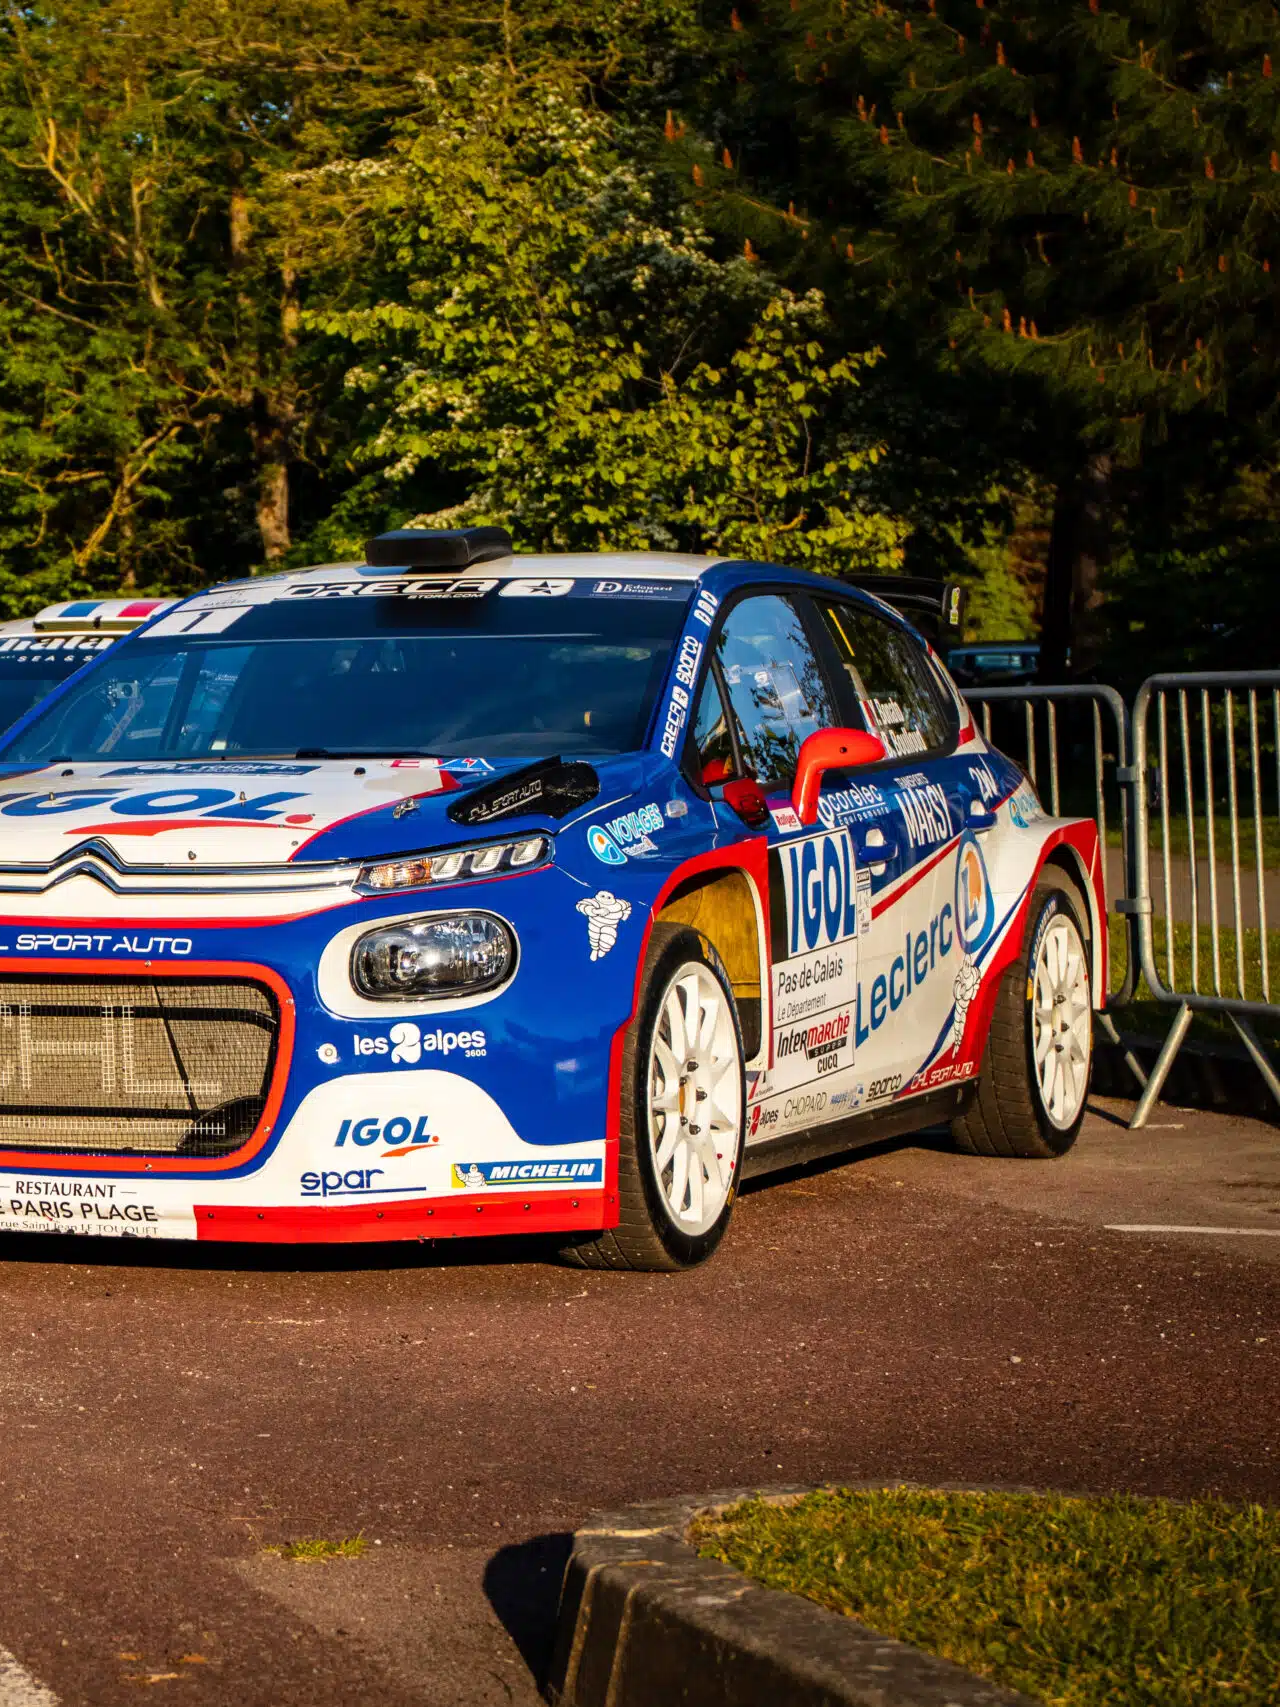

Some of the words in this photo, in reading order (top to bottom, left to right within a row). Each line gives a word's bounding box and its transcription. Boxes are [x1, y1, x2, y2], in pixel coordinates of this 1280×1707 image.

[179, 611, 214, 632] 1
[675, 635, 703, 690] sparco
[519, 779, 542, 800] AUTO
[604, 803, 665, 845] VOYAGES
[894, 783, 955, 849] MARSY
[789, 834, 856, 954] IGOL
[16, 934, 112, 952] SPORT
[112, 936, 193, 954] AUTO
[855, 902, 953, 1050] Leclerc
[354, 1034, 387, 1055] les
[390, 1022, 421, 1064] 2
[423, 1028, 487, 1056] alpes
[465, 1048, 487, 1058] 3600
[817, 1053, 839, 1073] CUCQ
[868, 1074, 903, 1099] sparco
[783, 1091, 828, 1119] CHOPARD
[489, 1162, 596, 1180] MICHELIN
[15, 1180, 117, 1198] RESTAURANT
[10, 1200, 74, 1219] PARIS
[80, 1203, 159, 1222] PLAGE
[0, 1220, 20, 1228] rue
